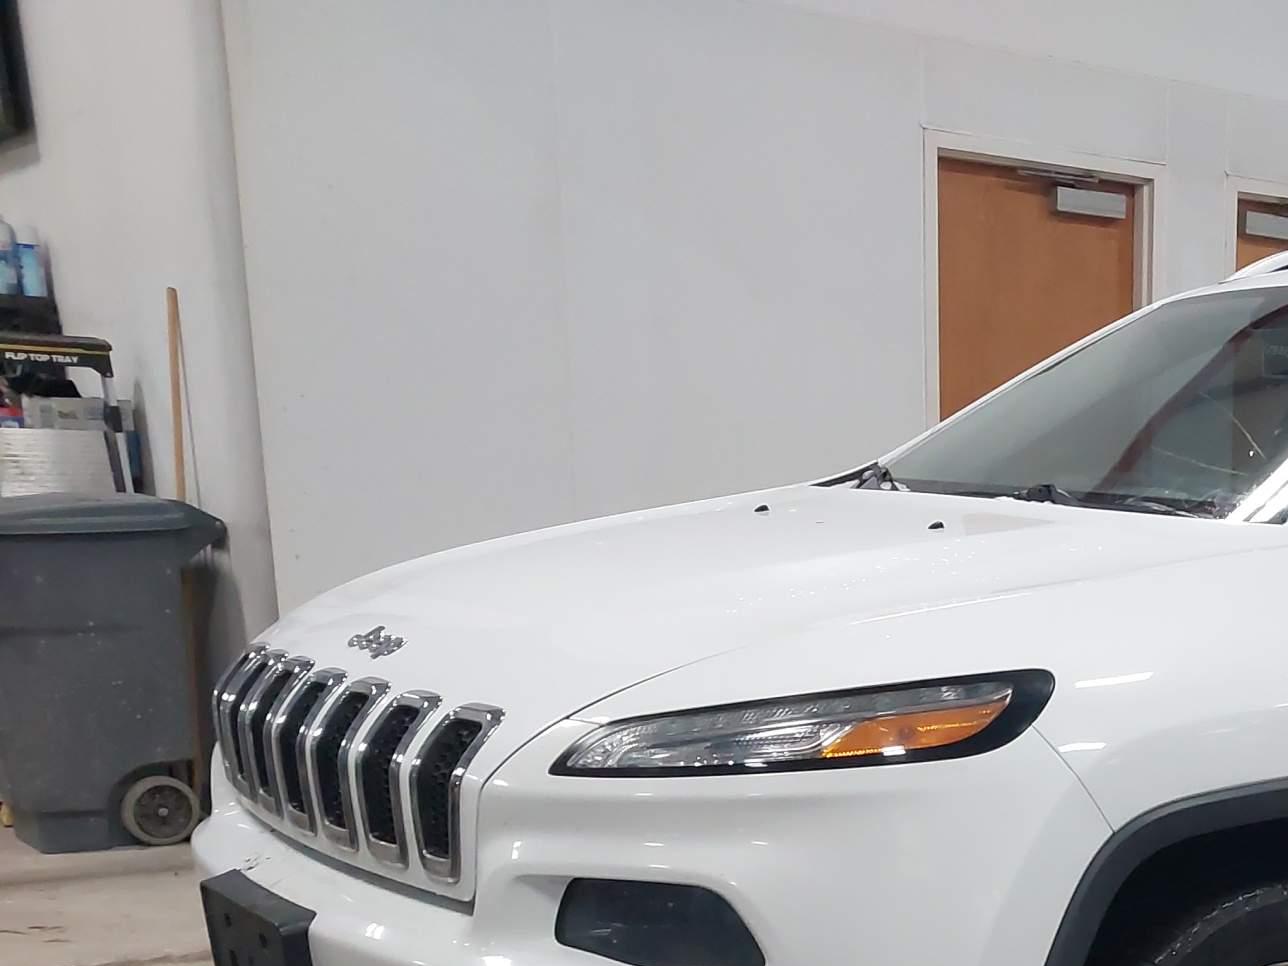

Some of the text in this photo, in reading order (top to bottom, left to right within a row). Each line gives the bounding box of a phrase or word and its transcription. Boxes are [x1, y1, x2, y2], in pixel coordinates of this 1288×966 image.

[4, 352, 79, 363] FLIP TOP TRAY
